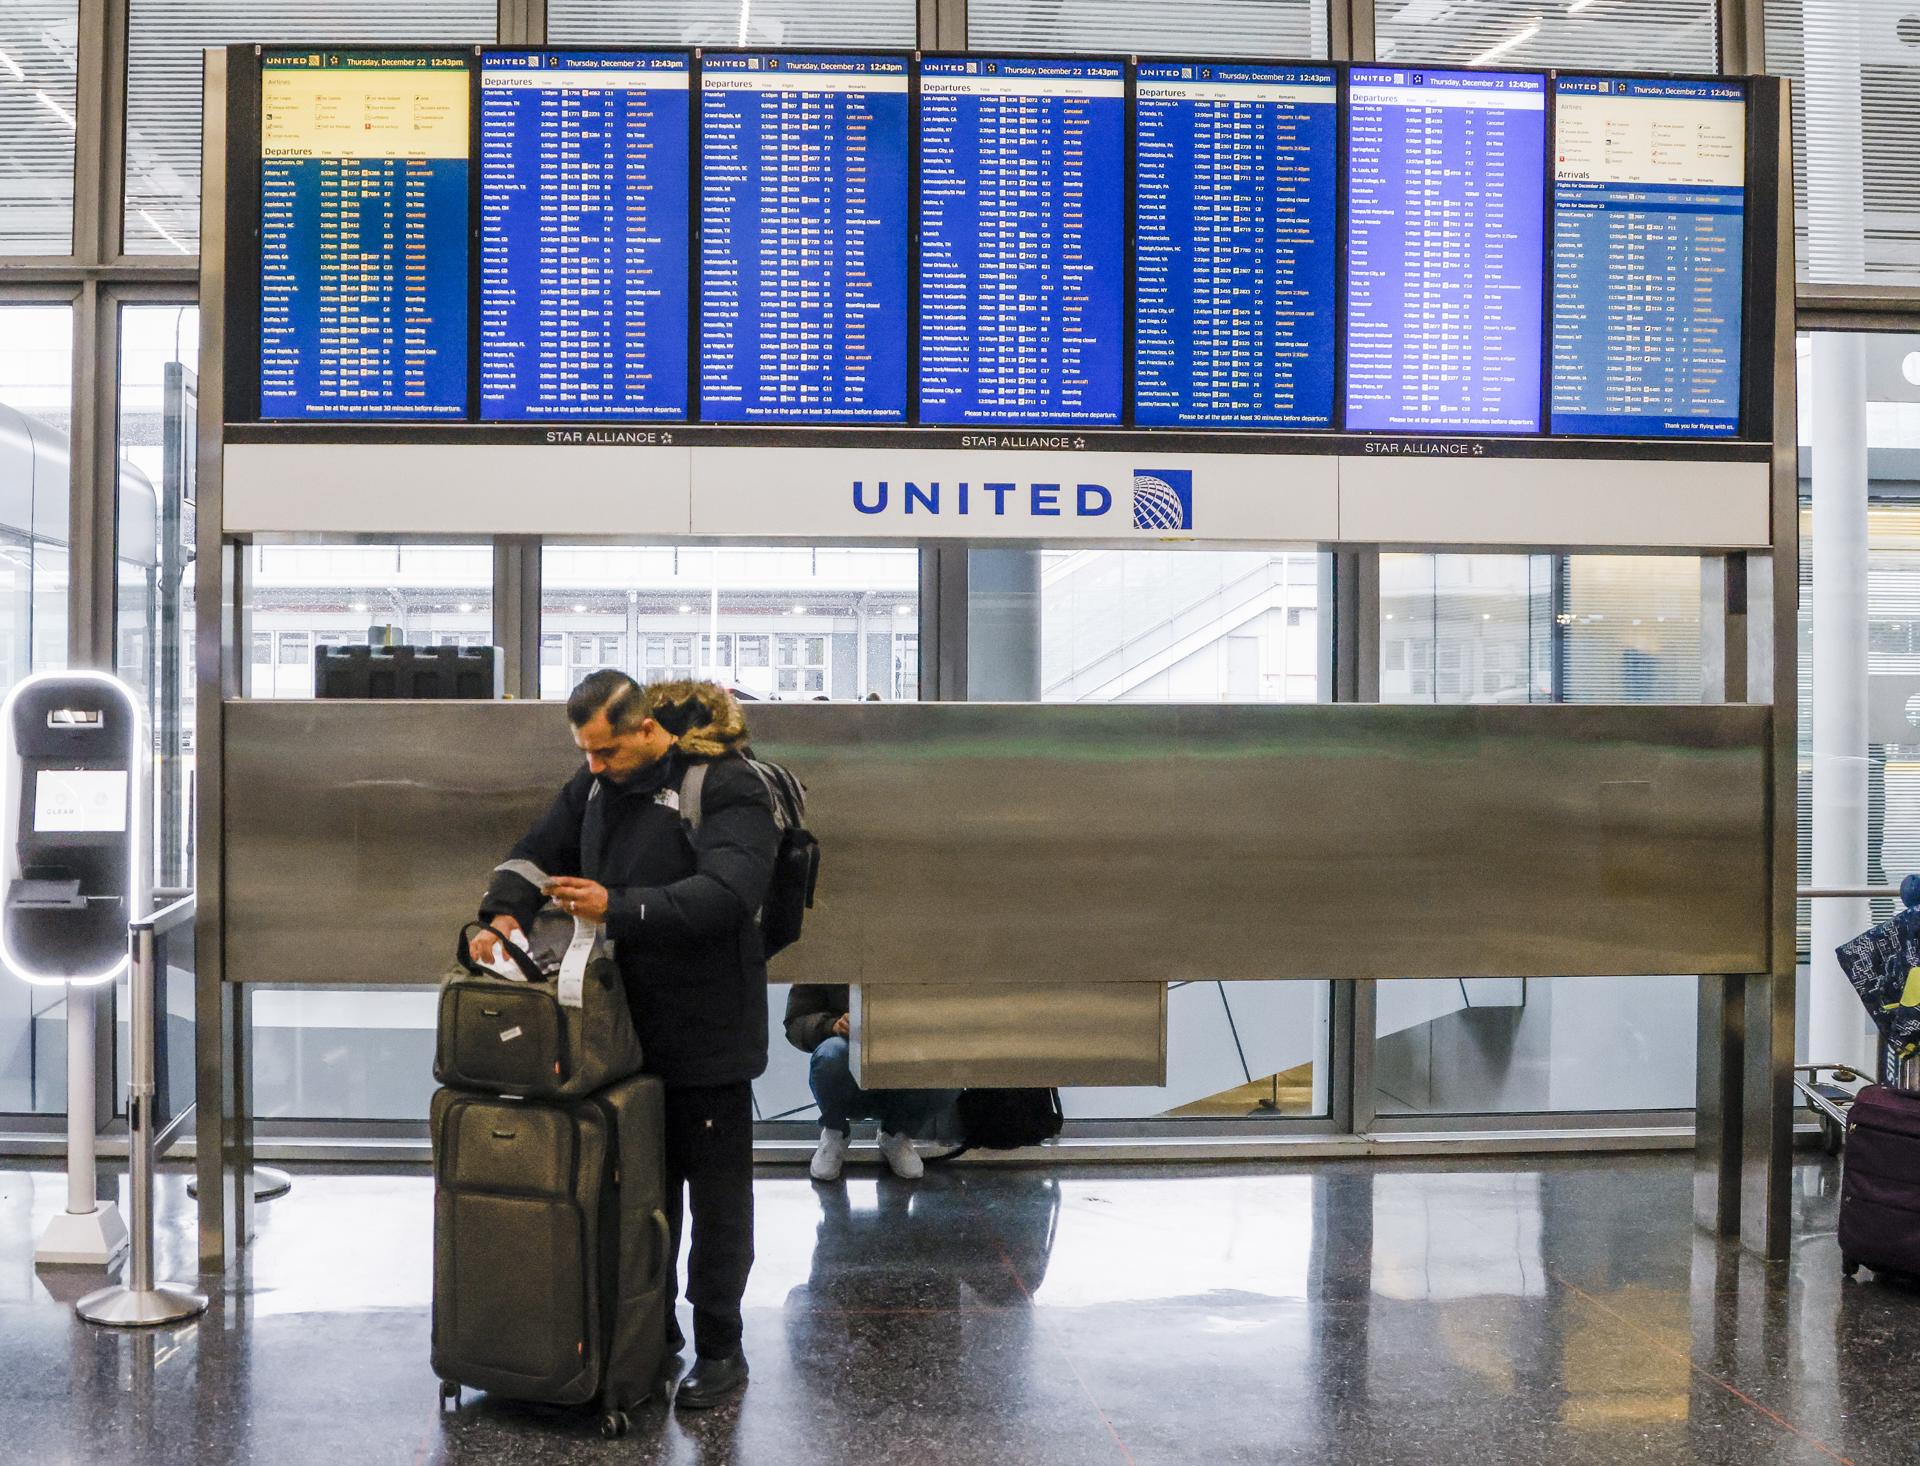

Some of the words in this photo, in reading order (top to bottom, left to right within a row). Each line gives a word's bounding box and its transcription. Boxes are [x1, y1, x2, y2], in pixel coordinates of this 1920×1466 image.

[651, 60, 683, 68] 12:43pm
[871, 63, 902, 71] 12:43pm
[1087, 68, 1118, 76] 12:43pm
[1300, 74, 1331, 82] 12:43pm
[1509, 81, 1539, 89] 12:43pm
[1711, 89, 1740, 98] 12:43pm
[1352, 94, 1398, 103] Departures
[1558, 171, 1590, 179] Arrivals
[547, 431, 582, 442] STAR
[587, 432, 656, 443] ALLIANCE
[962, 436, 997, 446] STAR
[1001, 437, 1069, 447] ALLIANCE
[1365, 443, 1399, 453] STAR
[1403, 444, 1468, 454] ALLIANCE
[853, 482, 1112, 516] UNITED
